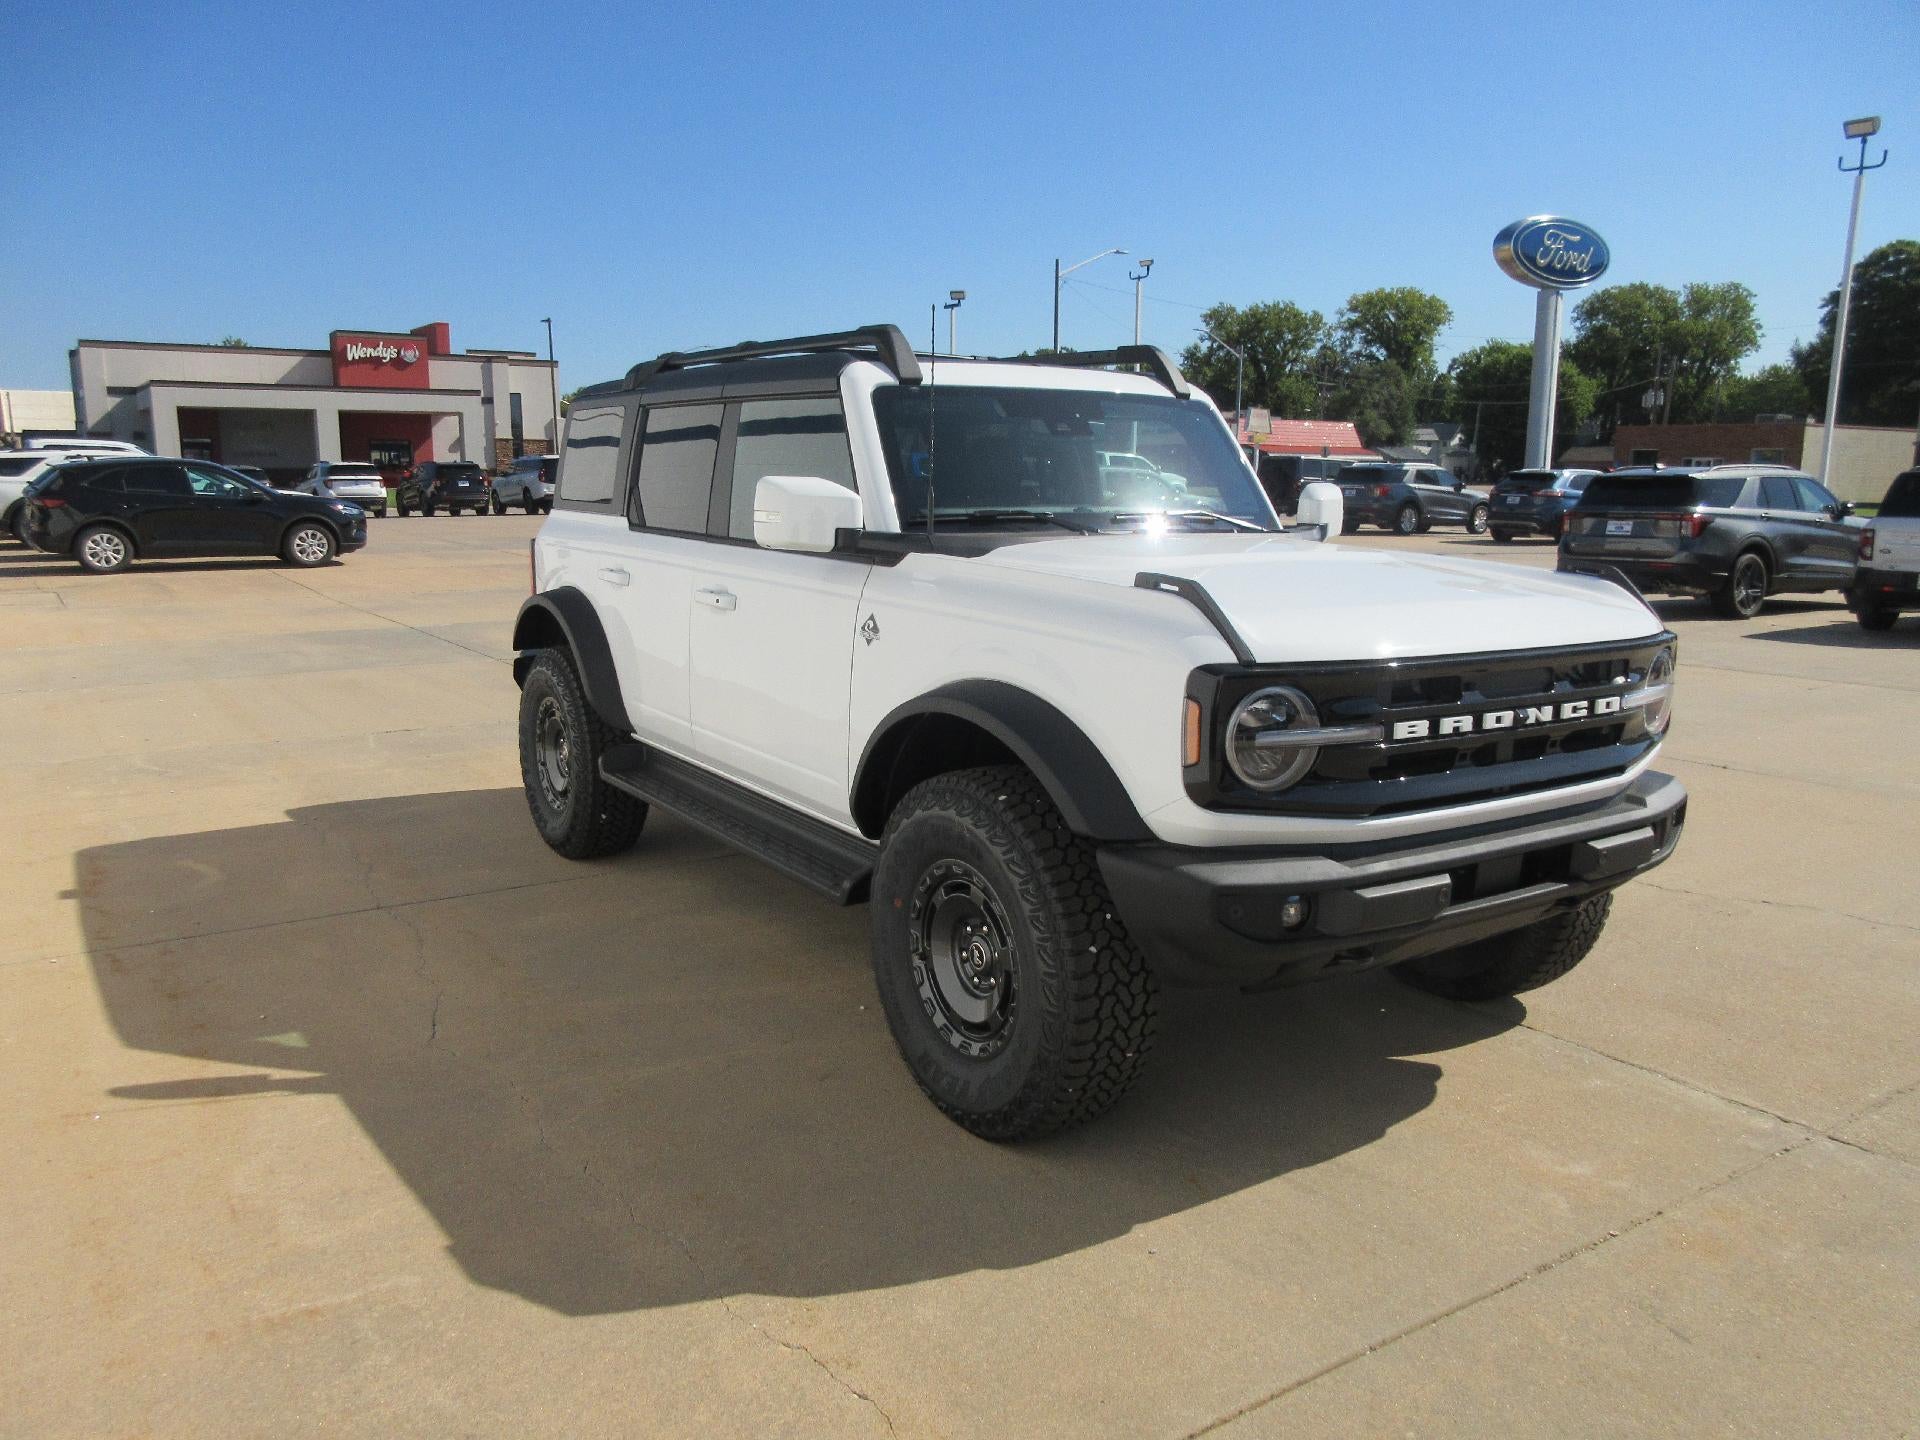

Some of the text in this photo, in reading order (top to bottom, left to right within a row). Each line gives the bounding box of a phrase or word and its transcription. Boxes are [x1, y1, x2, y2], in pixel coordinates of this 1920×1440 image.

[1536, 229, 1593, 273] Ford
[346, 341, 398, 363] Wendy's
[1393, 696, 1621, 740] BRONCO
